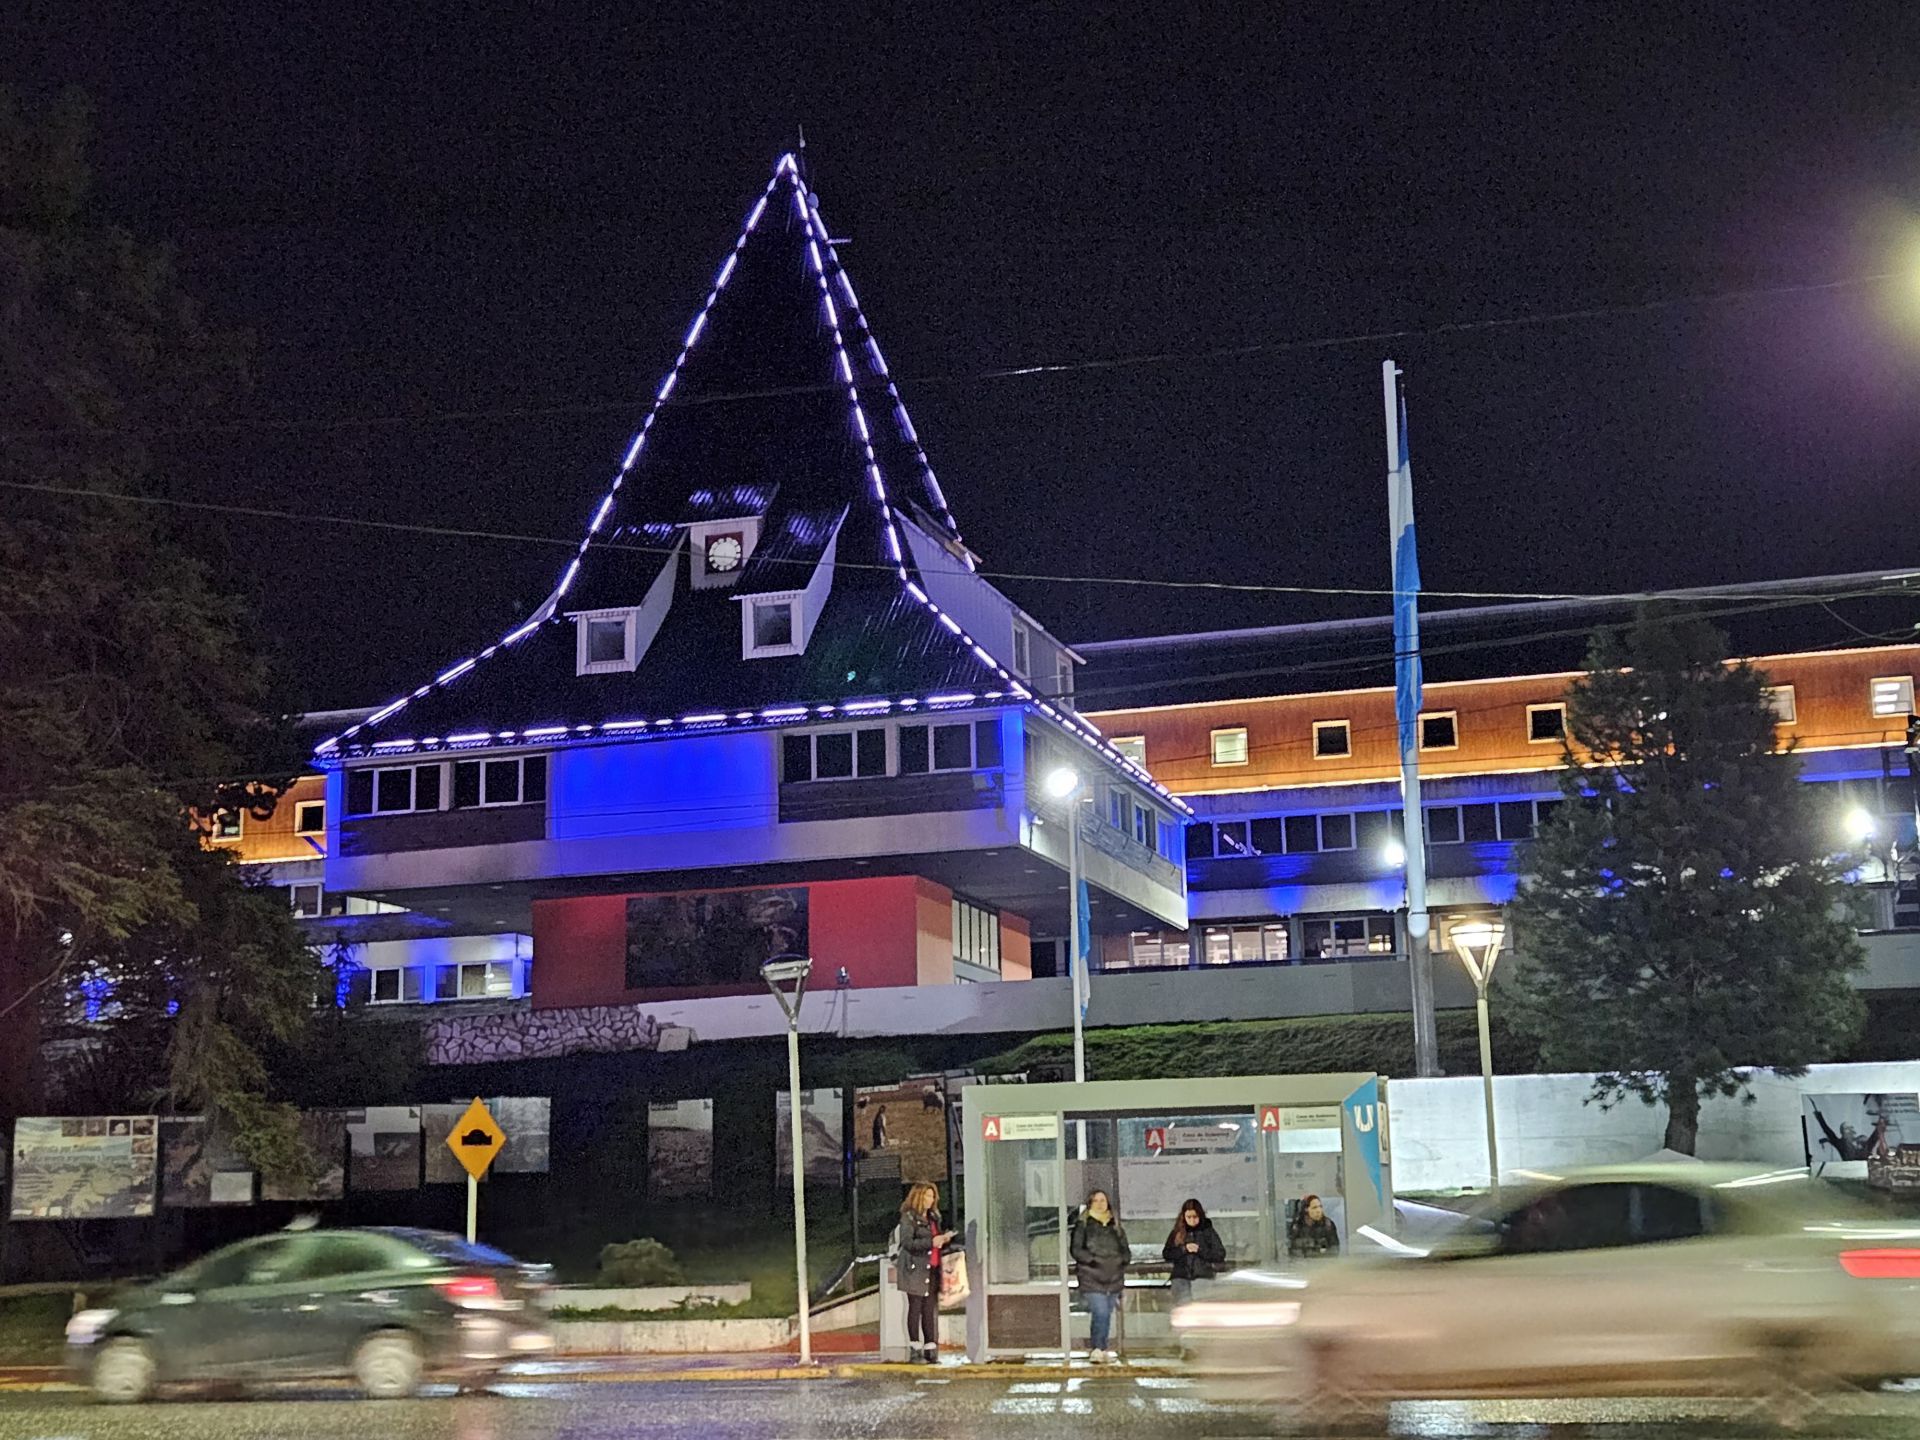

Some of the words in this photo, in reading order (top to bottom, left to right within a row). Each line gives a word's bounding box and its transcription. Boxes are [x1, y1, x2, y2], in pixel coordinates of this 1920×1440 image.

[1263, 1111, 1277, 1127] A
[1353, 1104, 1374, 1132] U
[984, 1120, 999, 1136] A
[1147, 1130, 1162, 1146] A
